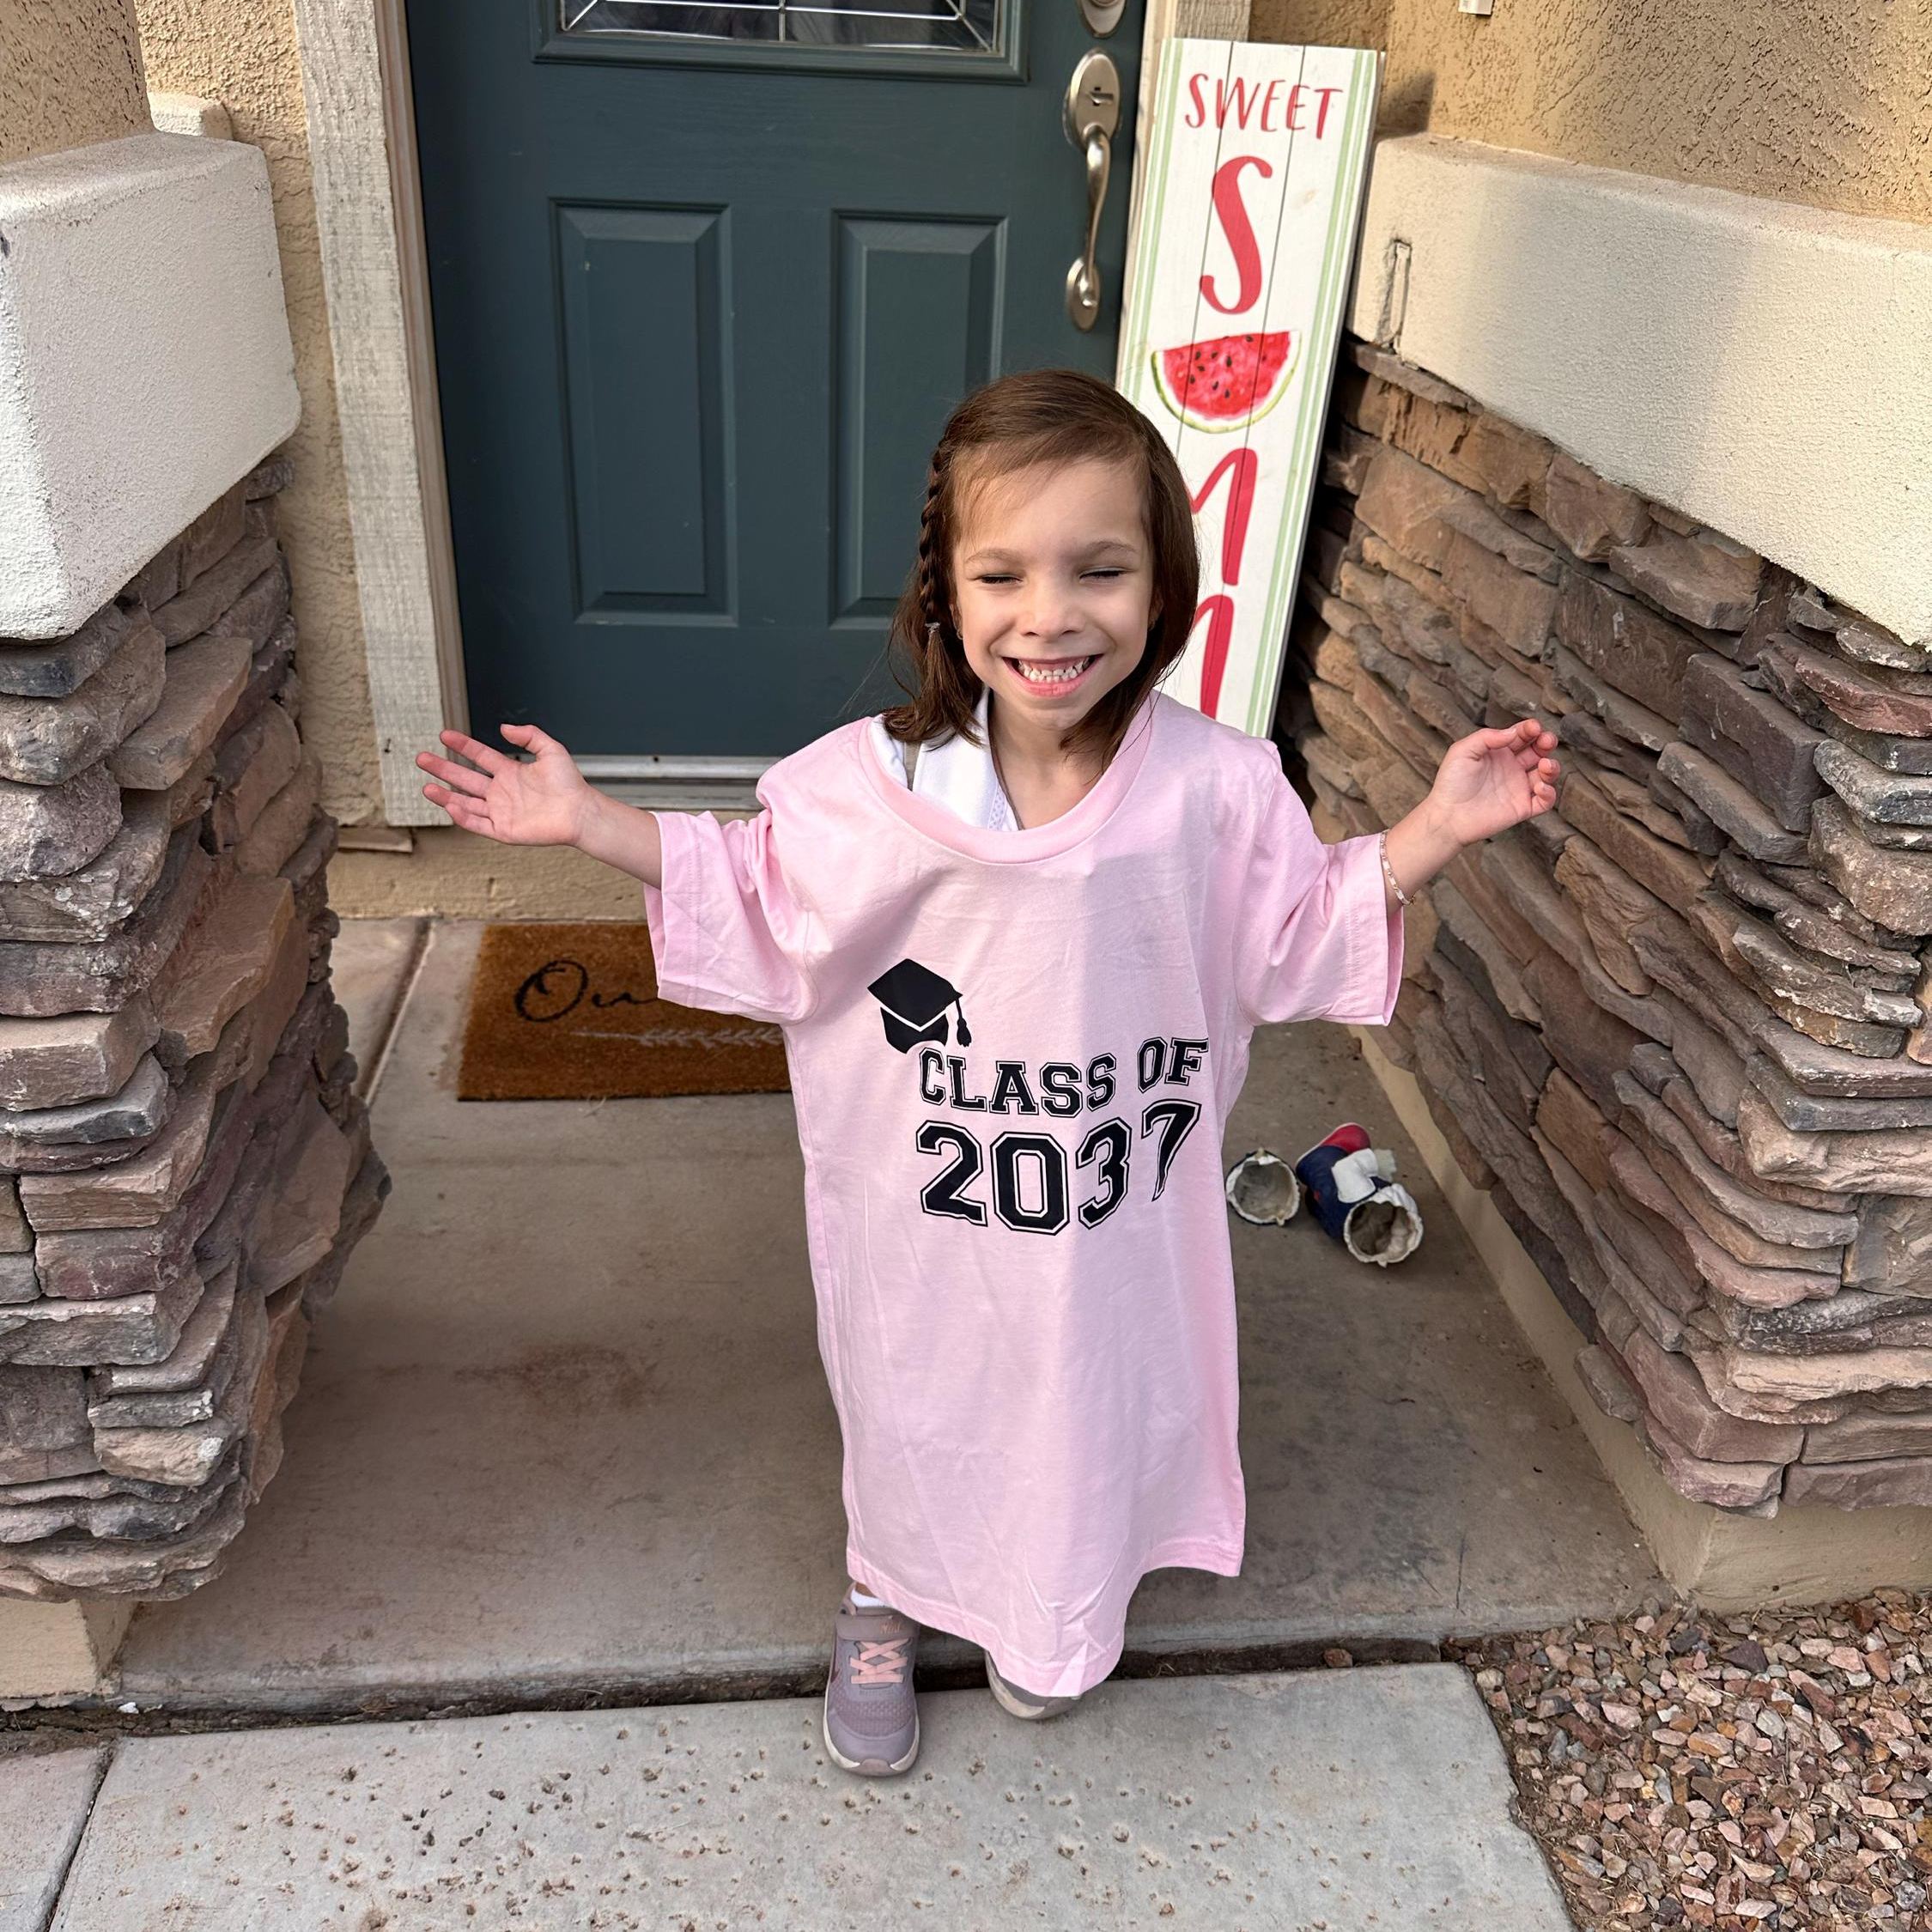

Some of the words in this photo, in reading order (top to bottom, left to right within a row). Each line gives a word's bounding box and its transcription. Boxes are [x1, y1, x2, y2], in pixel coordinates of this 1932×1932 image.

[1185, 73, 1344, 139] SWEET
[920, 1048, 1117, 1118] CLASS
[1137, 1036, 1209, 1094] OF
[916, 1099, 1201, 1236] 2037
